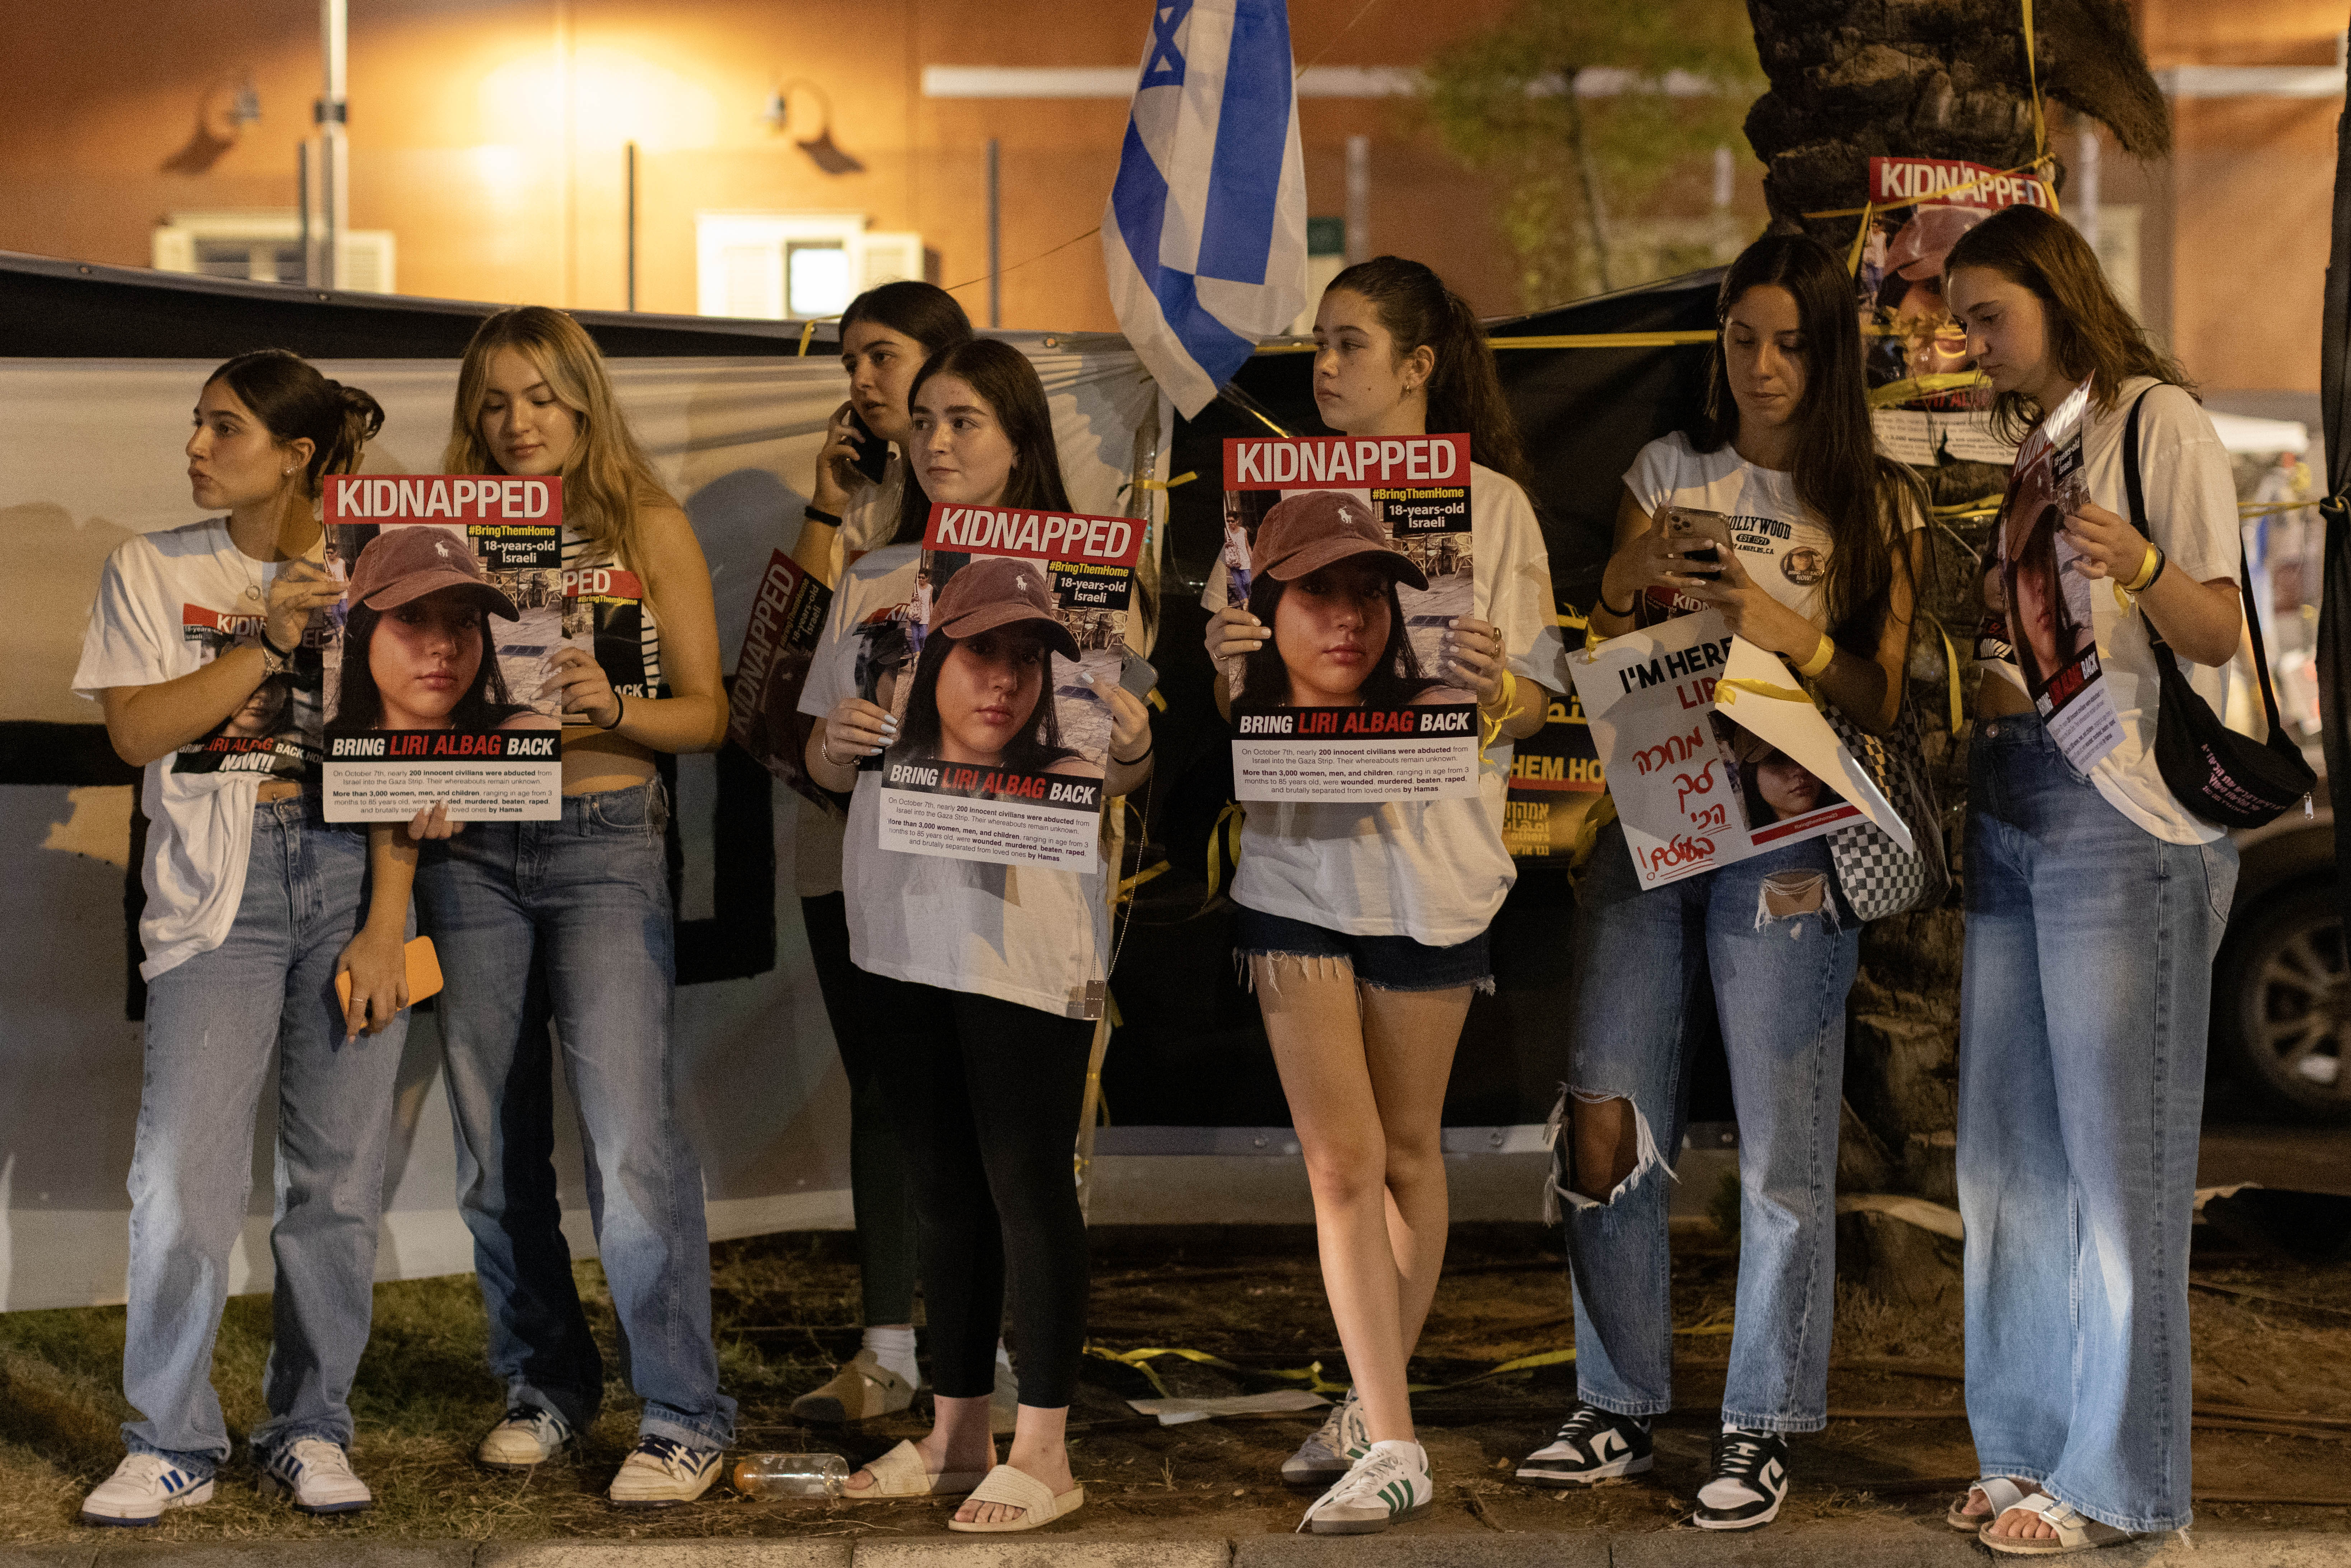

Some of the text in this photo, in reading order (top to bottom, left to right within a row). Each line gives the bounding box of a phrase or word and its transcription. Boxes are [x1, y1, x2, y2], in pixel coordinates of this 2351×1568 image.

[1236, 439, 1457, 483] KIDNAPPED
[336, 479, 549, 518] KIDNAPPED
[1372, 487, 1464, 501] #BringThemHome
[1388, 503, 1464, 517] 18-years-old
[468, 526, 555, 537] #BringThemHome
[936, 508, 1132, 559] KIDNAPPED
[1408, 516, 1445, 529] Israeli
[1728, 515, 1791, 540] OLLYWOOD
[484, 540, 555, 552] 18-years-old
[502, 553, 536, 564] Israeli
[1049, 561, 1129, 577] #BringThemHome
[1060, 577, 1126, 593] 18-years-old
[1074, 591, 1107, 603] Israeli
[730, 564, 793, 736] KIDNAPPED
[1618, 658, 1666, 694] I'M
[2081, 651, 2099, 680] BACK
[614, 683, 644, 697] ACK
[1239, 711, 1470, 733] BRING LIRI ALBAG BACK
[205, 738, 229, 752] IRI
[275, 743, 304, 759] BACK
[332, 734, 554, 756] BRING LIRI ALBAG BACK
[1632, 726, 1704, 775] מחכה
[1509, 755, 1606, 783] HEM HO
[889, 765, 1097, 804] BRING LIRI ALBAG BACK
[899, 798, 922, 807] October
[970, 807, 997, 816] innocent
[999, 811, 1025, 819] civilians
[1044, 816, 1074, 825] abducted
[955, 814, 969, 822] Strip.
[988, 819, 1026, 828] whereabouts
[1690, 803, 1726, 830] הכי
[994, 831, 1021, 840] children,
[1023, 835, 1046, 844] ranging
